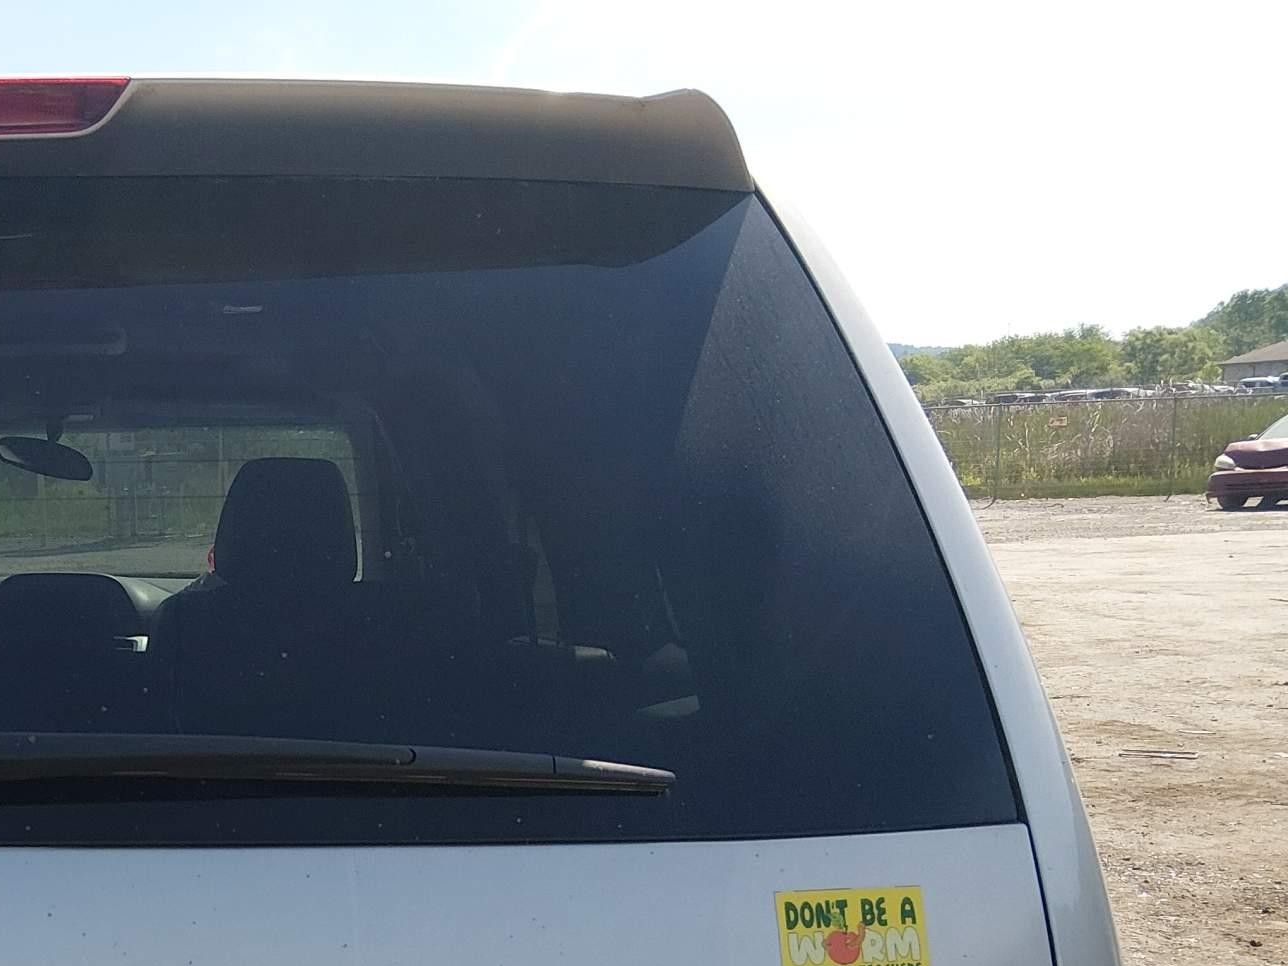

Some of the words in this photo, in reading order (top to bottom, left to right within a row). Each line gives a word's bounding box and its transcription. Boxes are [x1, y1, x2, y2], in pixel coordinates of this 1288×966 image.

[784, 899, 848, 931] DON'T
[861, 896, 888, 927] BE
[900, 896, 917, 925] A
